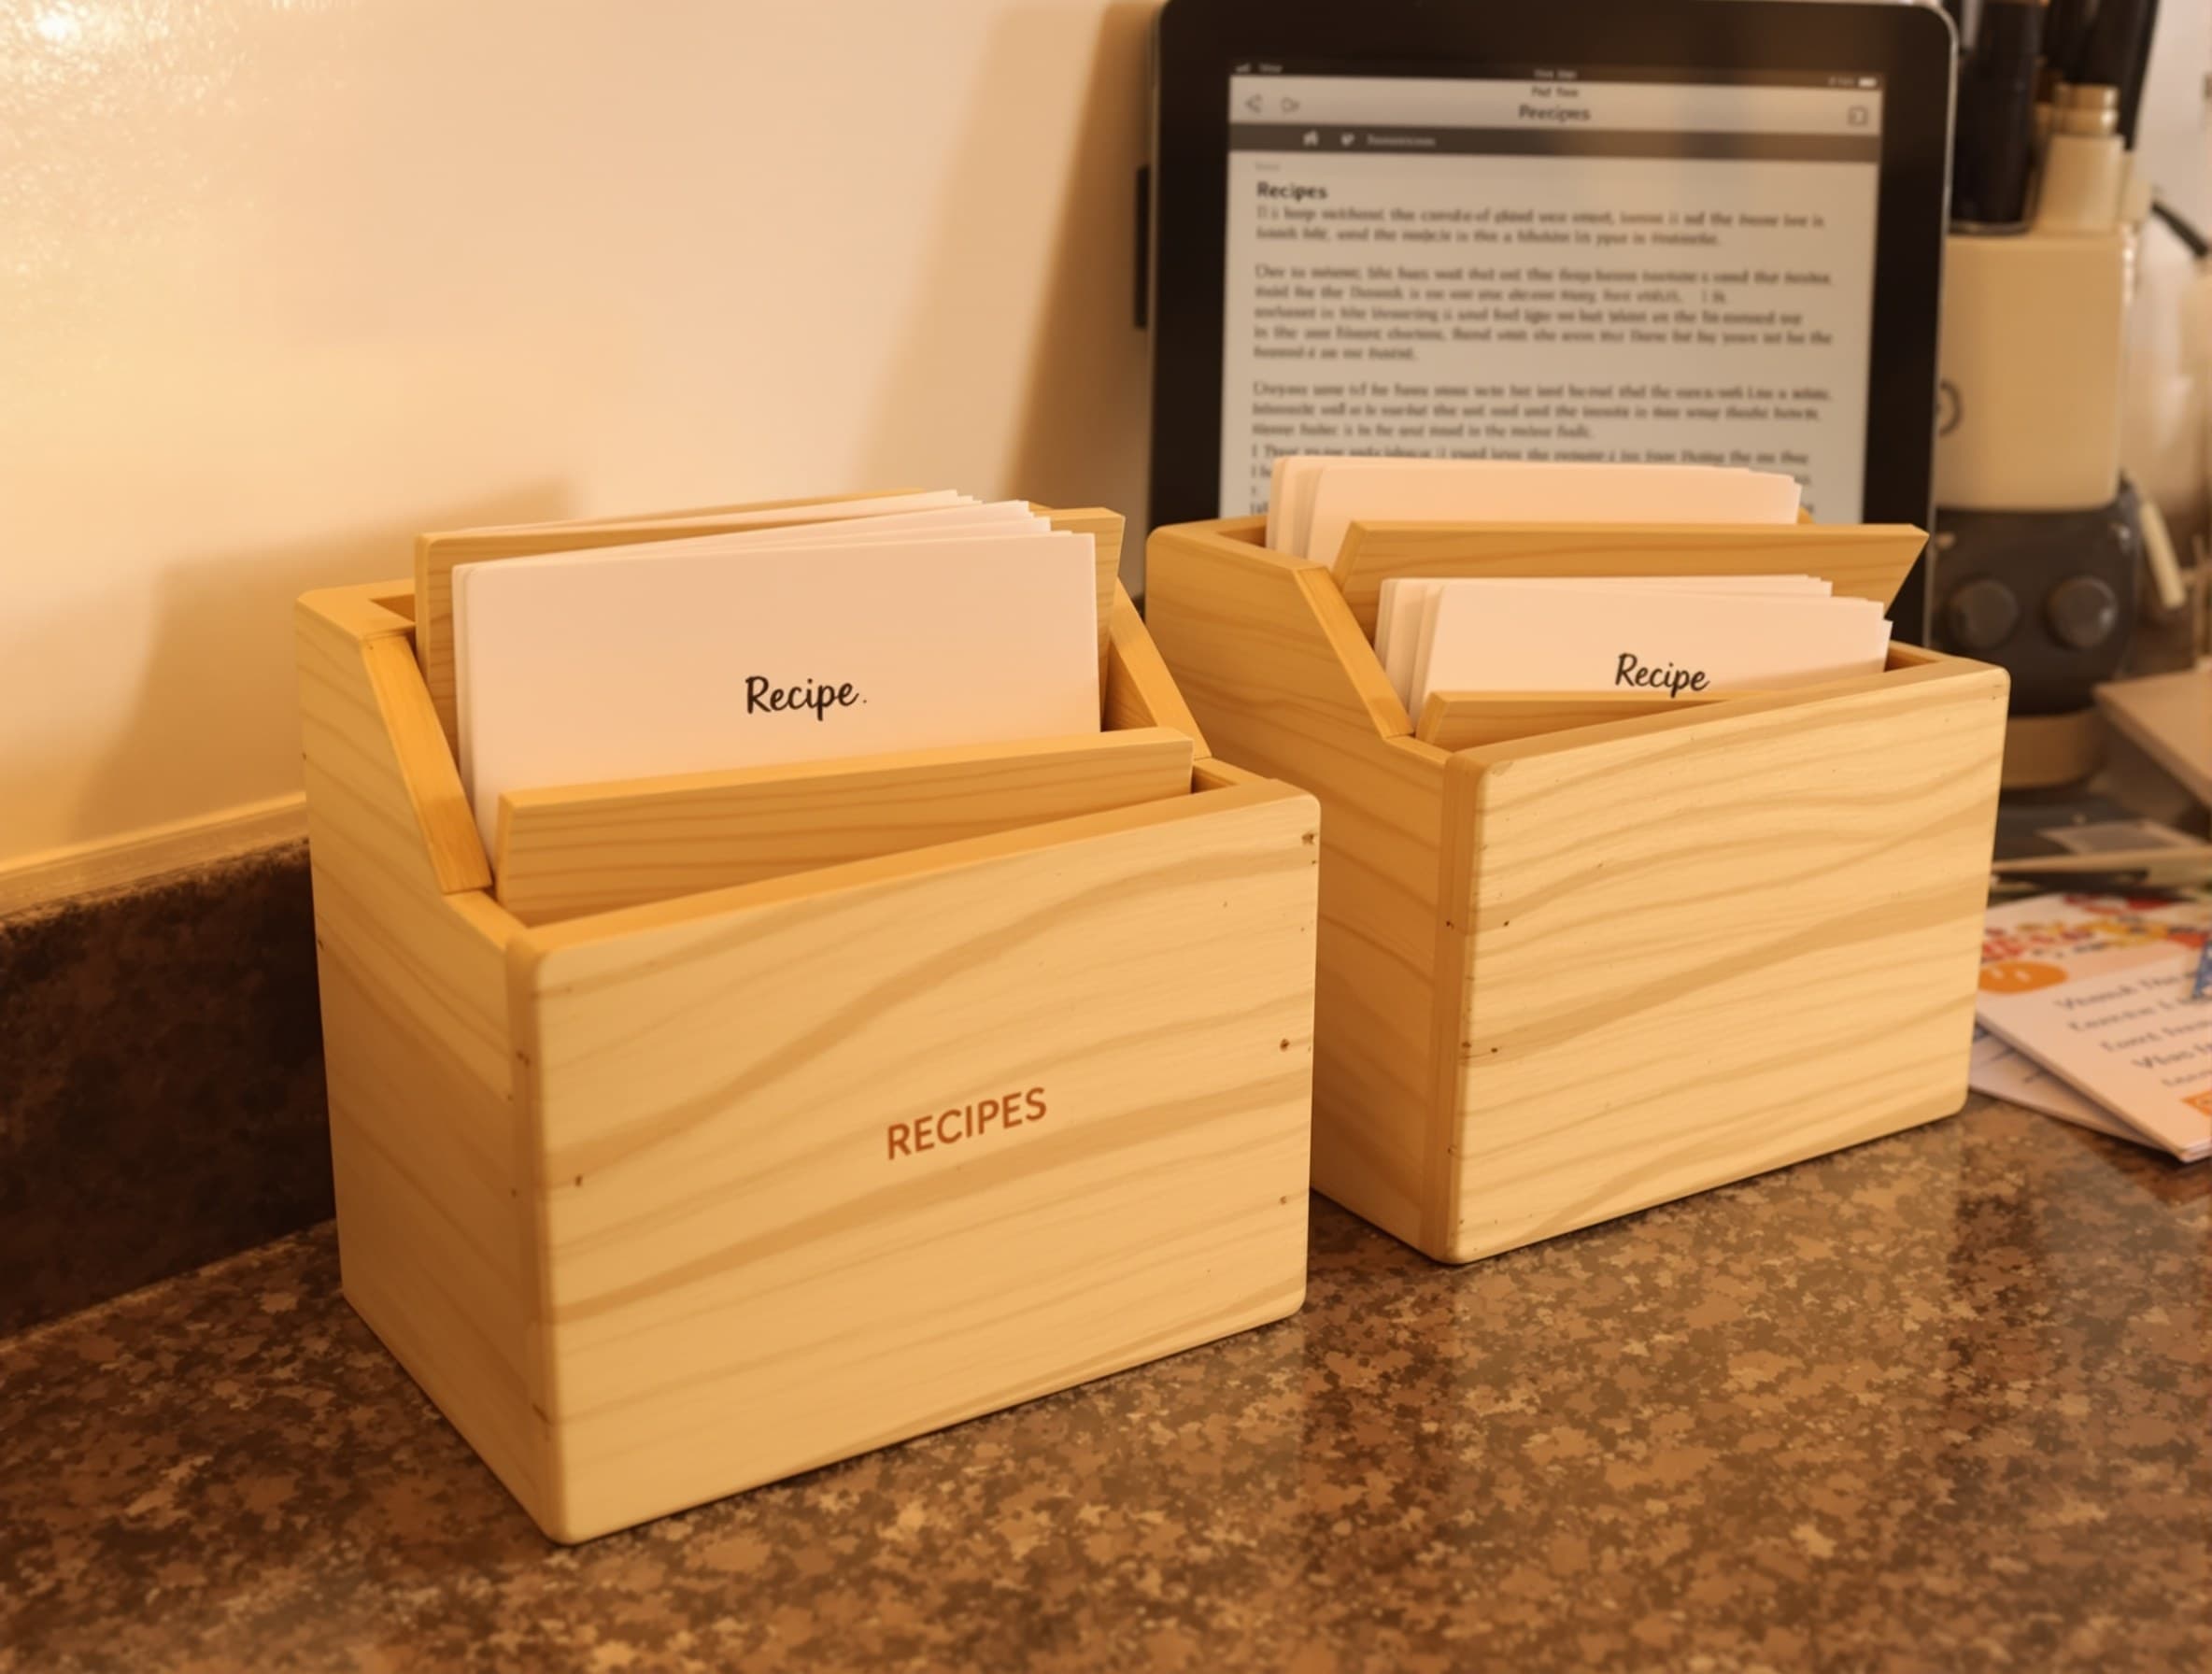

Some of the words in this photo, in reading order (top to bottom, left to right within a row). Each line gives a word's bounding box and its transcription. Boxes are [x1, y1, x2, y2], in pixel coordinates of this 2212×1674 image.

[1256, 181, 1328, 202] Recipes
[1614, 652, 1711, 699] Recipe
[887, 1087, 1047, 1160] RECIPES
